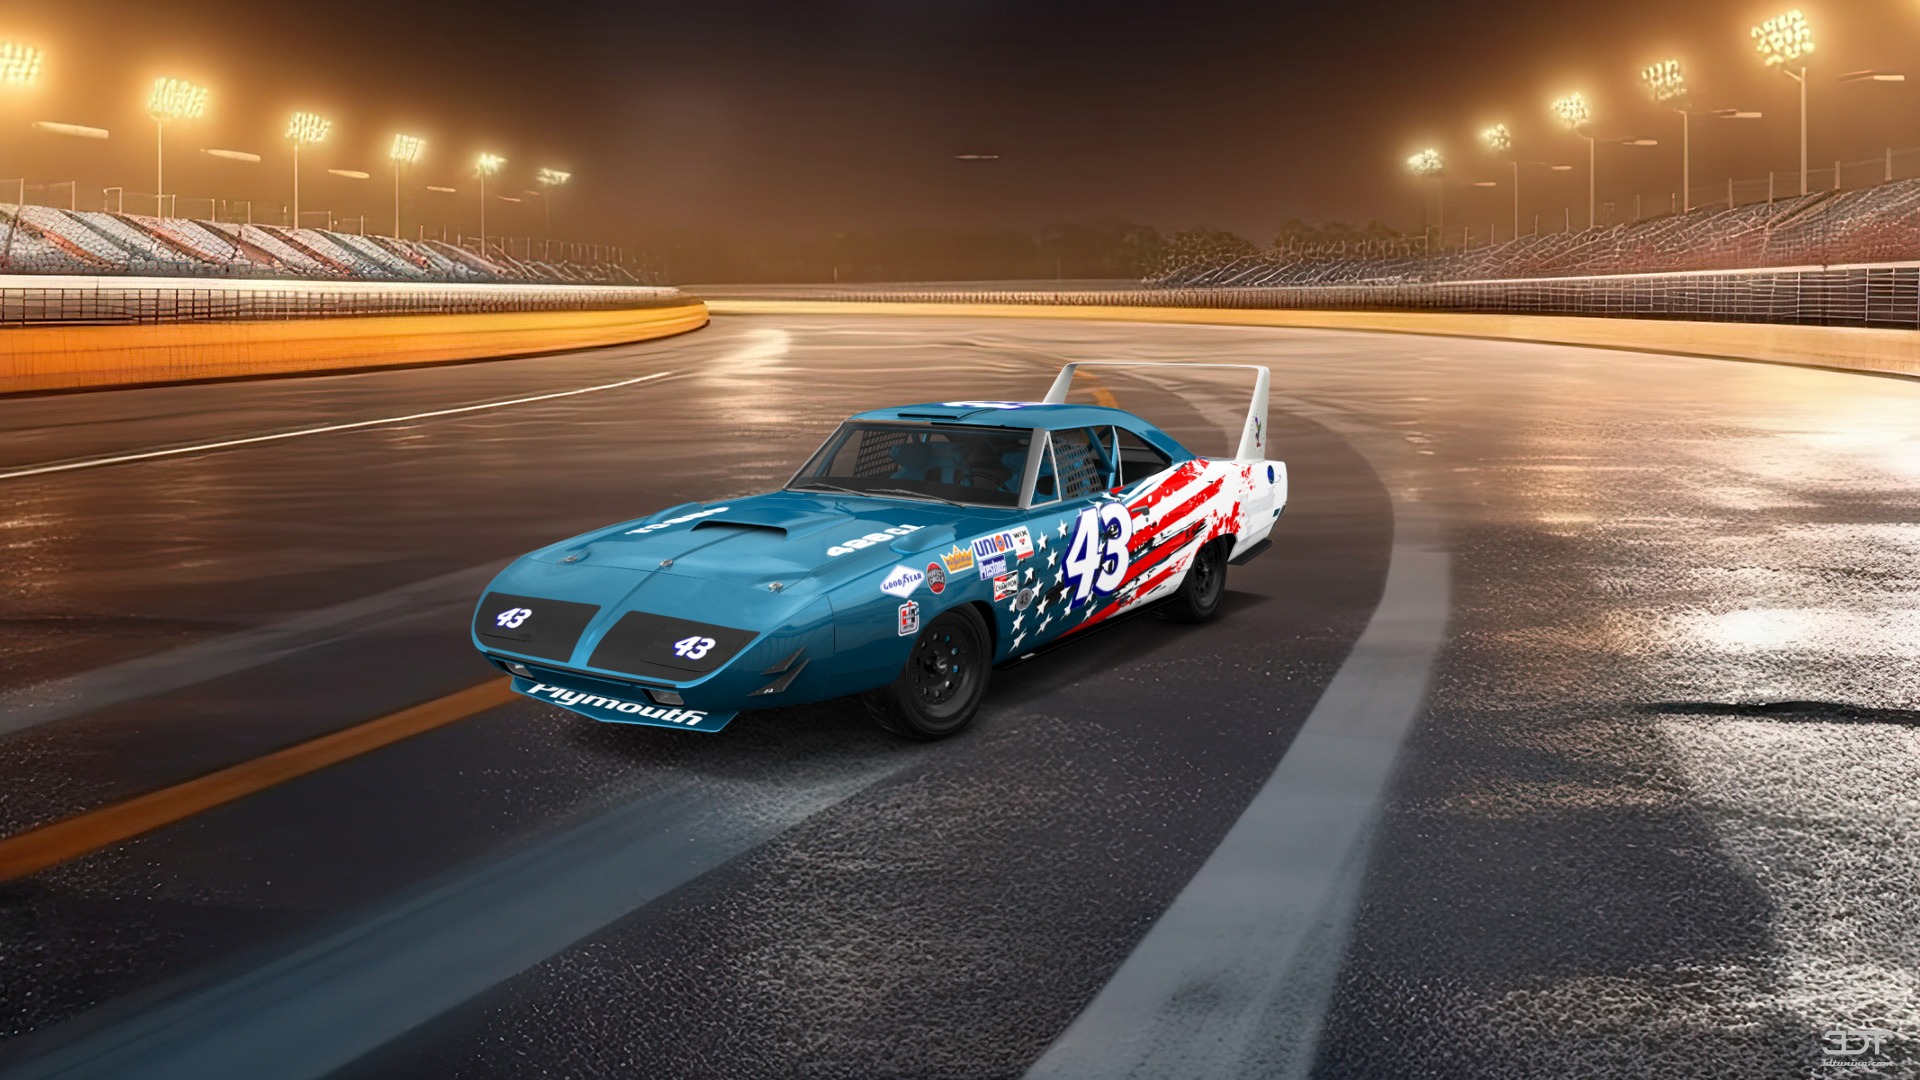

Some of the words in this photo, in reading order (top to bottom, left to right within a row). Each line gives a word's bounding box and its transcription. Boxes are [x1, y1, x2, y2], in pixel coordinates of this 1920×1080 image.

[974, 533, 1014, 557] UNION
[1013, 529, 1028, 539] WIX
[1061, 502, 1134, 609] 43
[883, 572, 922, 590] GOODYEAR
[978, 559, 1007, 580] Prestone
[496, 607, 533, 629] 43
[672, 636, 716, 660] 43
[526, 682, 709, 727] Plymouth
